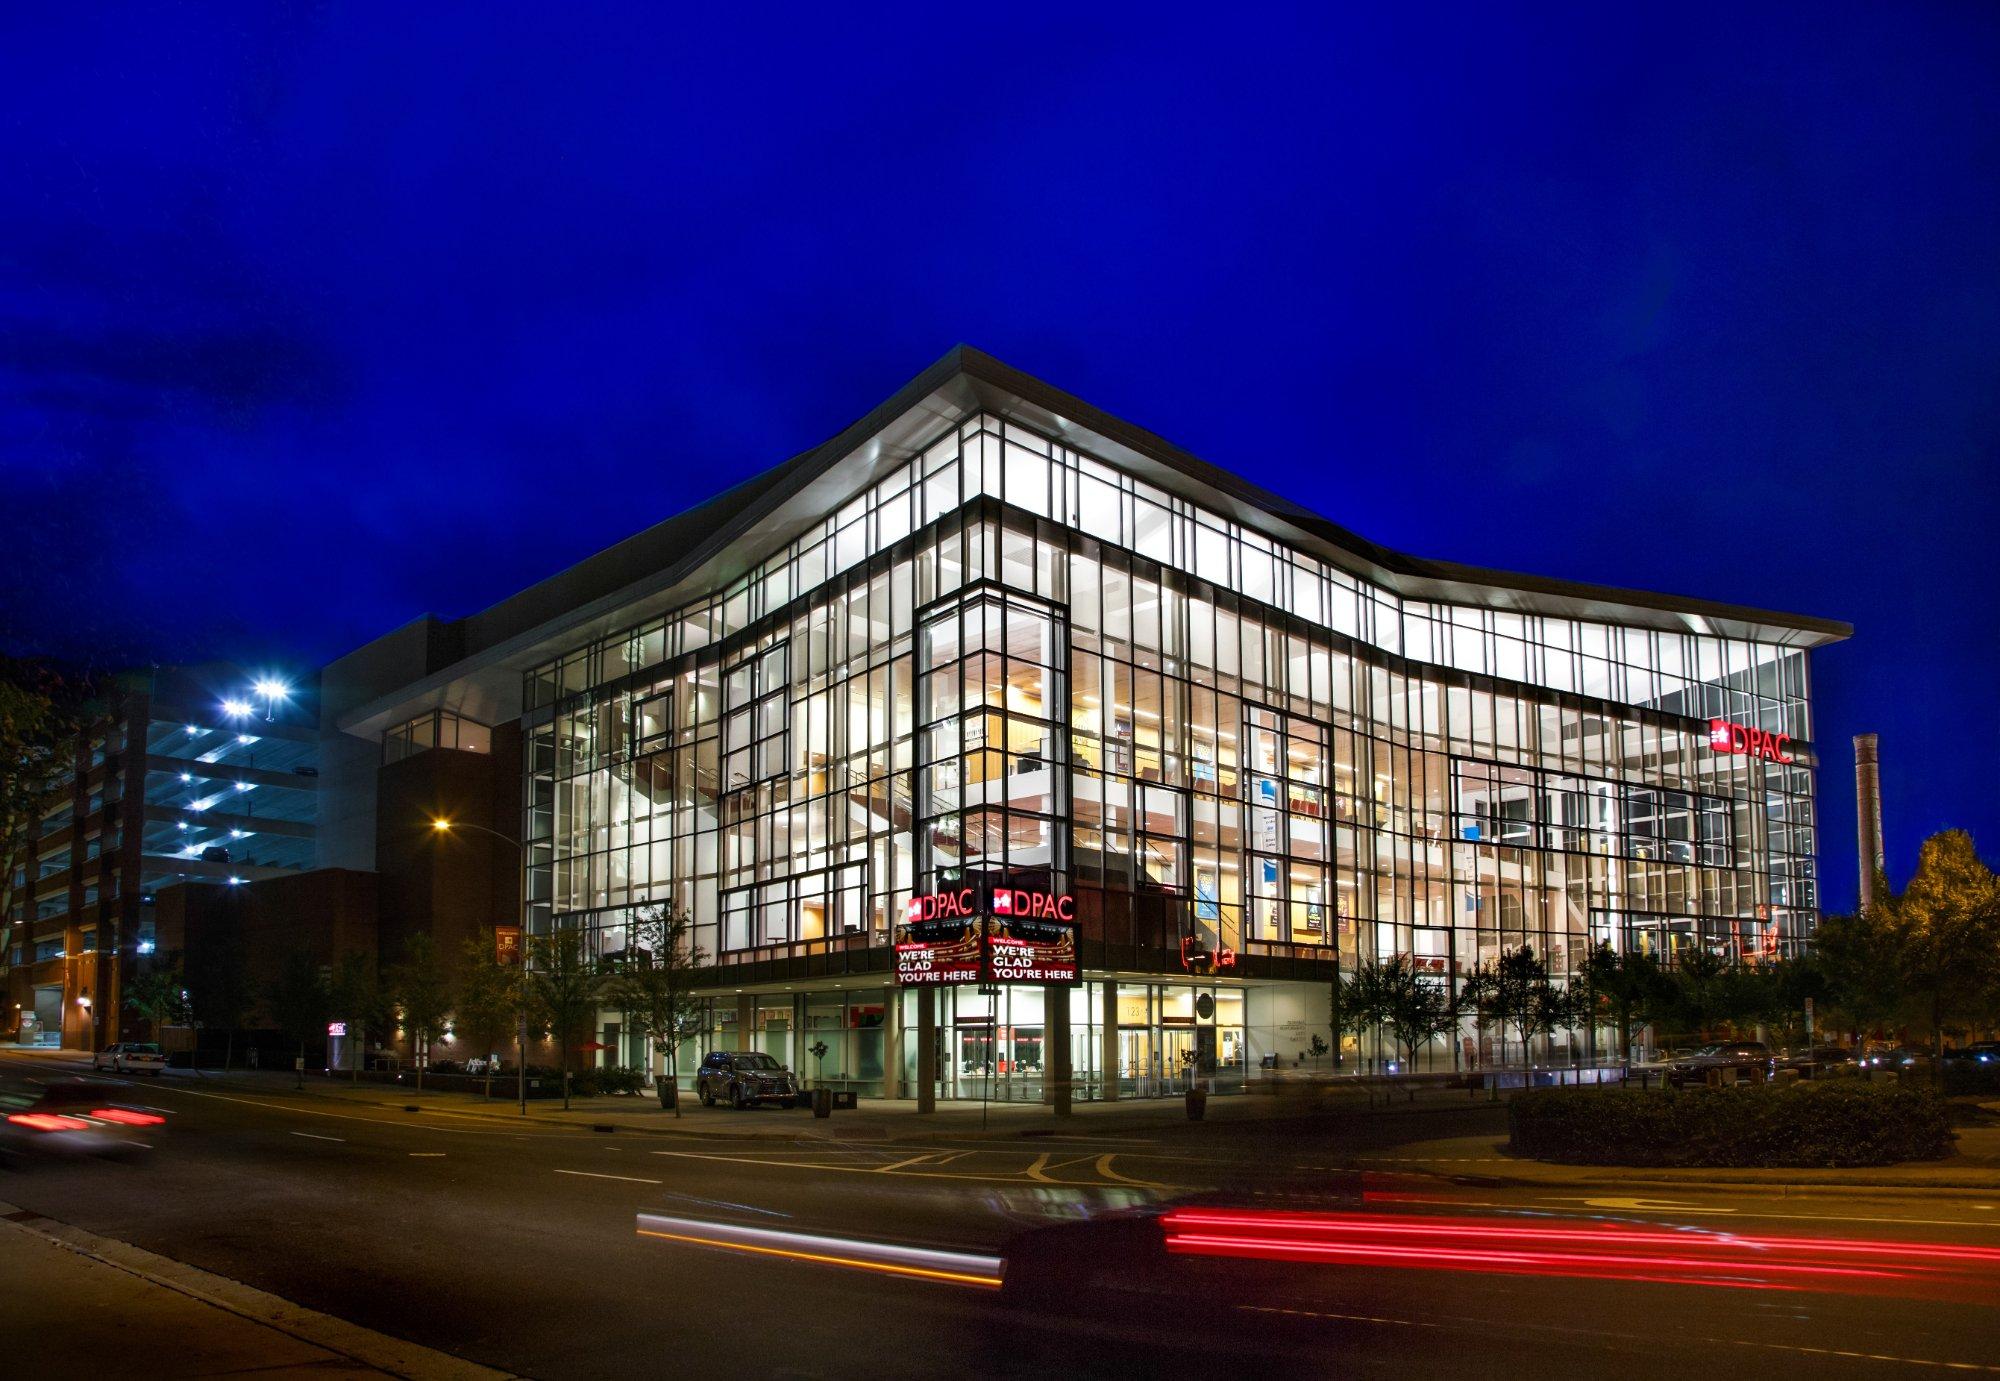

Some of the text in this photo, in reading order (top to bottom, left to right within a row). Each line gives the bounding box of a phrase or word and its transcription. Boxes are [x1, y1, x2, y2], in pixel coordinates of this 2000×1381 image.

[1731, 723, 1794, 764] DPAC
[923, 888, 973, 920] DPAC
[1014, 890, 1073, 921] DPAC
[498, 943, 519, 951] DPAC
[993, 944, 1035, 957] WE'RE
[898, 950, 935, 960] WE'RE
[898, 961, 932, 972] GLAD
[993, 956, 1033, 968] GLAD
[898, 970, 977, 983] YOU'RE HERE
[993, 968, 1074, 980] YOU'RE HERE
